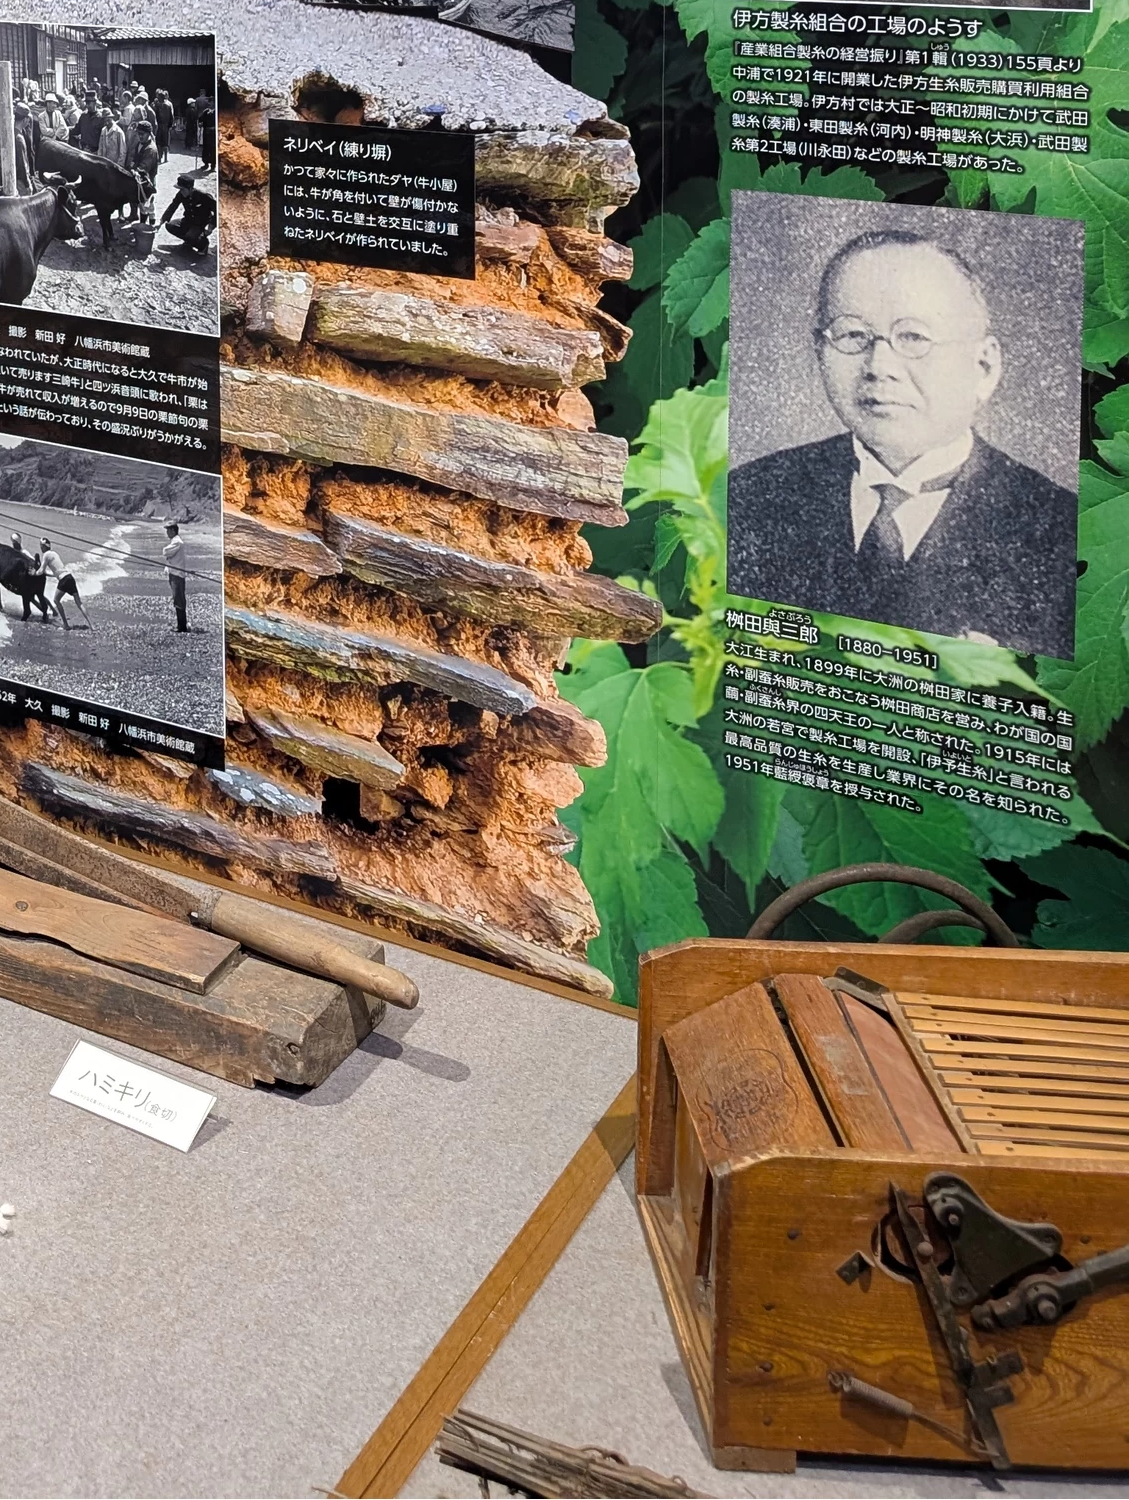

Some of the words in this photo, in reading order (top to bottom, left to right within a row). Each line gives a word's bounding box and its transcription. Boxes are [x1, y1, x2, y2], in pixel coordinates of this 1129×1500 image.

[733, 10, 983, 37] 伊方製糸組合の工場のようす
[930, 42, 950, 51] しゅう
[732, 66, 1089, 100] 中浦で1921年に開業した伊方生糸販売購買利用組合
[283, 185, 459, 213] には、牛が角を付いて壁が傷付かな
[284, 207, 459, 236] いように、石と壁土を交互に塗り重
[284, 226, 449, 257] ねたネリベイが作られていました。
[8, 325, 27, 339] 撮影
[35, 329, 54, 342] 新田
[56, 332, 66, 345] 好
[74, 336, 151, 359] 八幡浜市美術館蔵
[726, 611, 819, 645] 桝田與三郎
[768, 609, 813, 625] よさぶろう
[726, 641, 1073, 727] 大江生まれ、1899年に大洲の桝田家に養子入籍。生
[749, 683, 782, 696] ふくさんし
[25, 698, 43, 713] 大久
[51, 704, 70, 719] 撮影
[78, 712, 98, 728] 新田
[100, 717, 109, 731] 好
[118, 723, 196, 755] 八幡浜市美術館蔵
[725, 709, 1071, 799] 大洲の若宮で製糸工場を開設、「伊予生糸」と言われる
[774, 757, 829, 777] らんじゅほうしょう
[942, 749, 972, 764] いよいと
[725, 732, 1070, 825] 最高品質の生糸を生産し業界にその名を知られた。
[725, 755, 922, 813] 1951年藍綬褒章を授与された。
